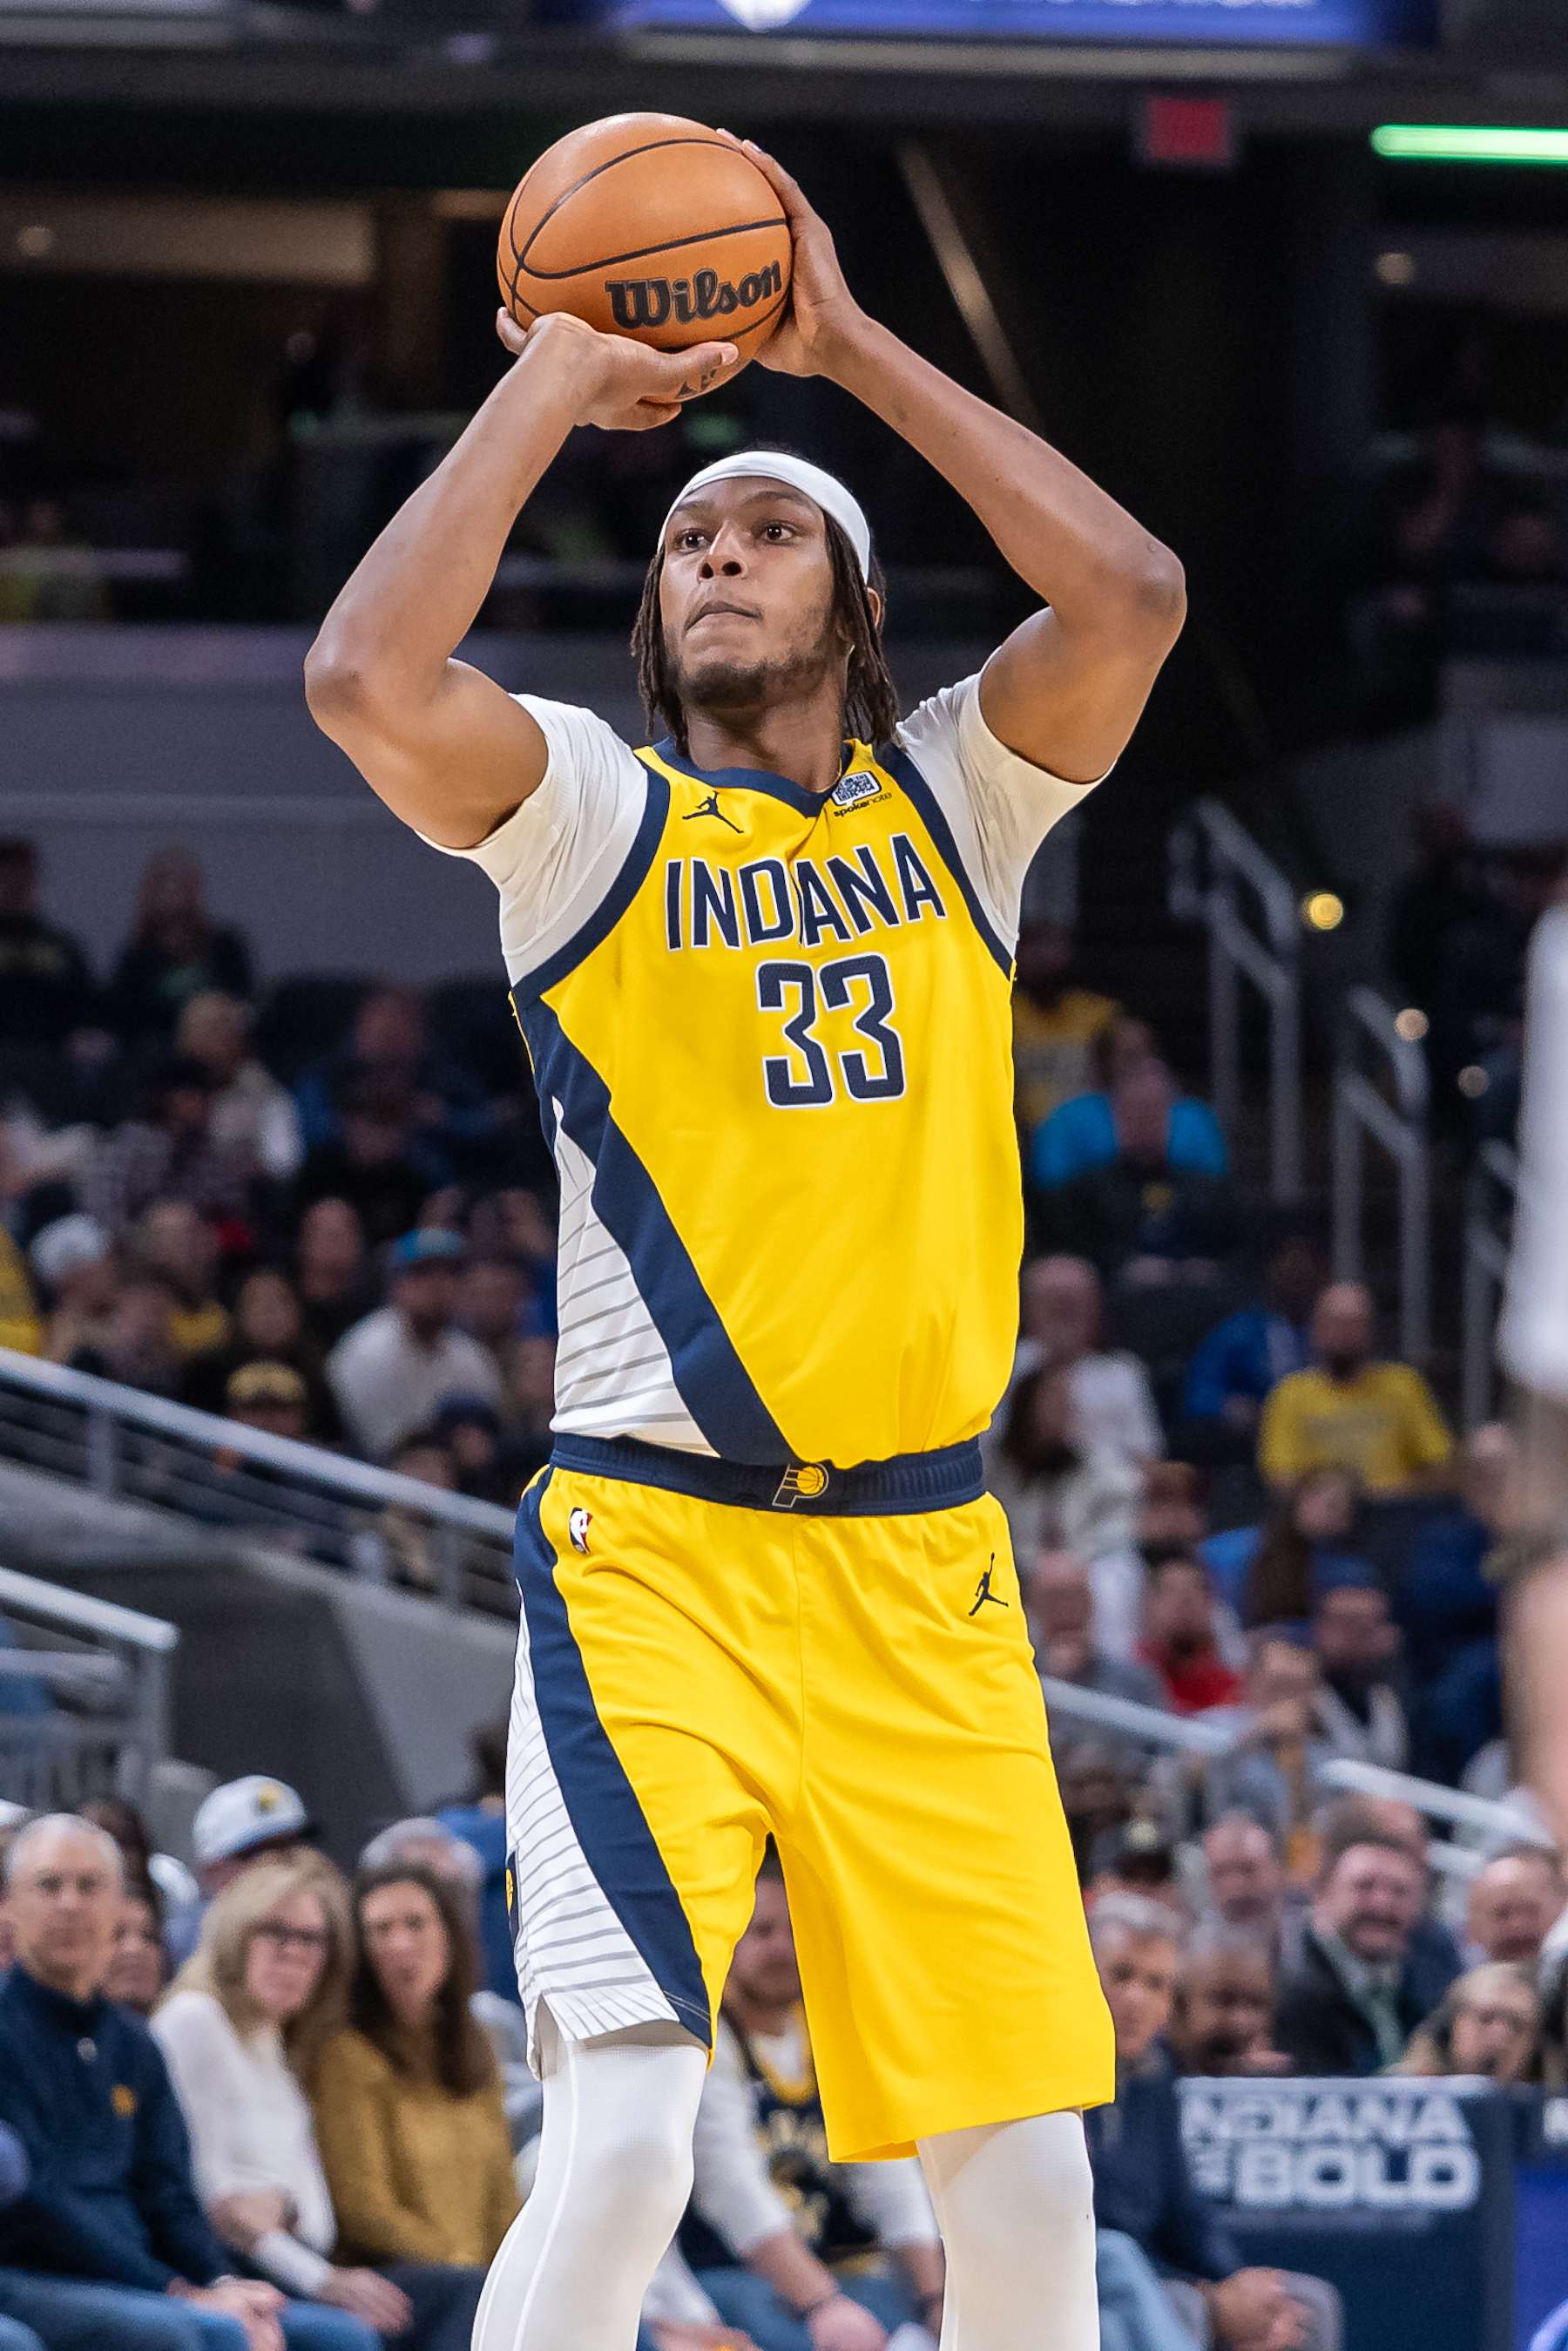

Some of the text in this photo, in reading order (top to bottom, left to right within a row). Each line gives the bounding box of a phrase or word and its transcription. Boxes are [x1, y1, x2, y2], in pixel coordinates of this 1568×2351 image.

[605, 259, 782, 329] Wilson
[665, 831, 948, 952] INDANA
[755, 952, 907, 1108] 33
[1181, 2092, 1471, 2142] NDIANA
[1235, 2141, 1481, 2208] BOLD
